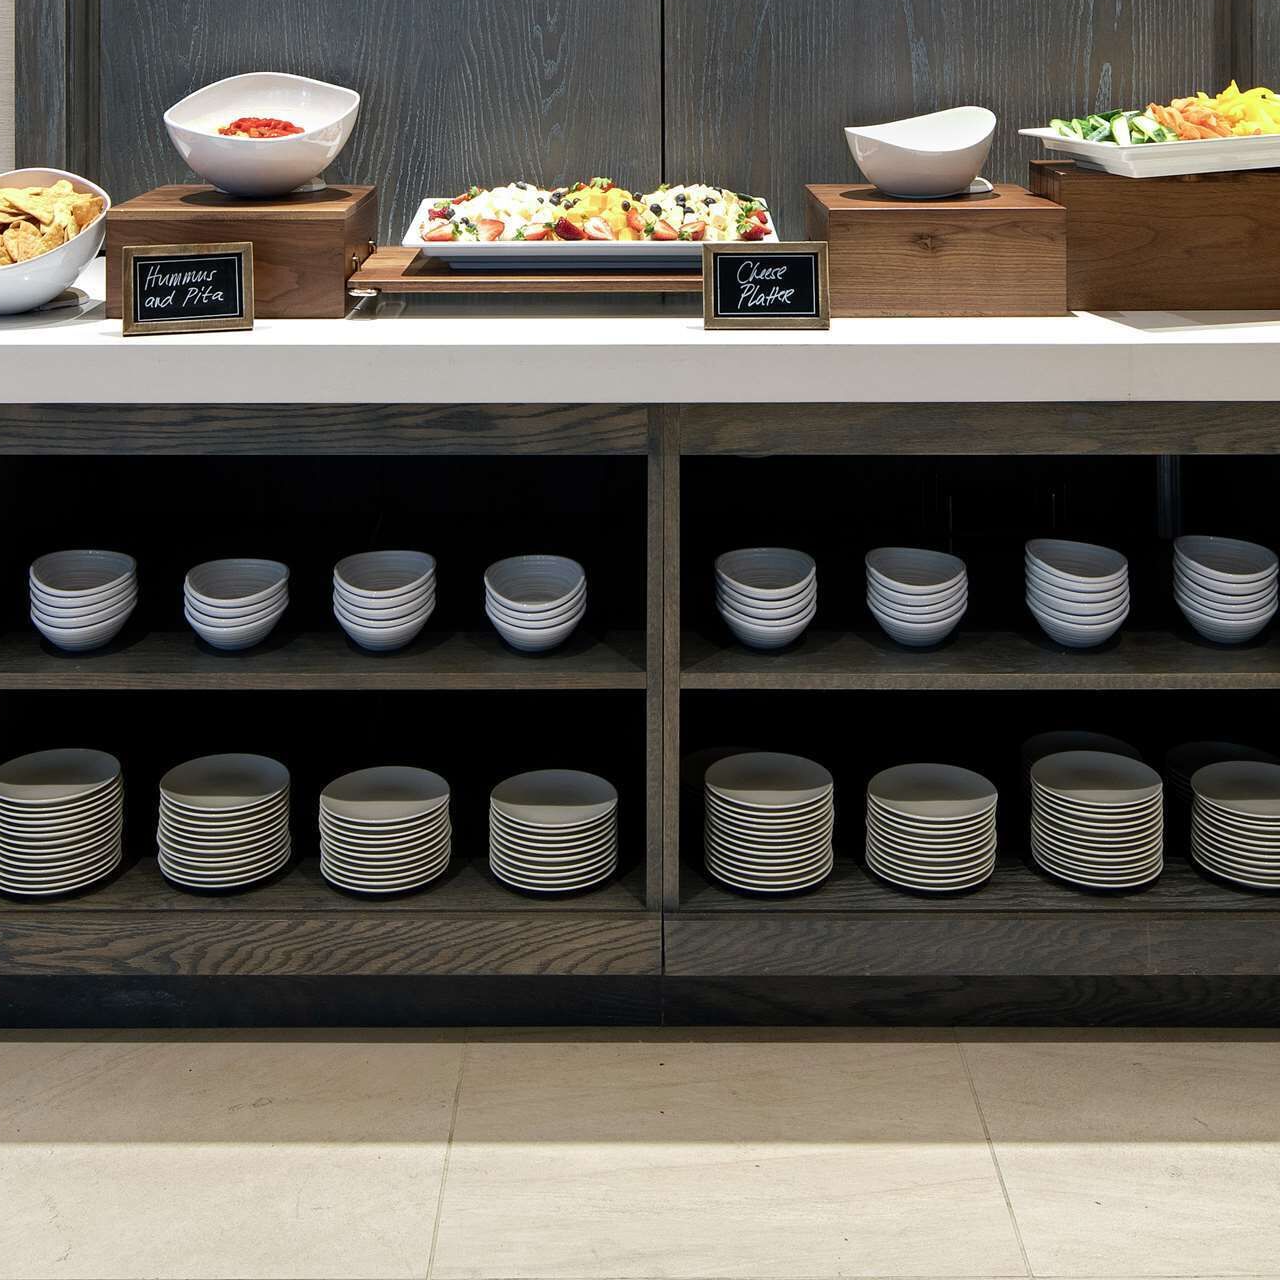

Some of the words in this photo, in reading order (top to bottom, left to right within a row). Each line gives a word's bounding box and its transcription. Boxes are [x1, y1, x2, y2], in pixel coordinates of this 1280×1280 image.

[144, 265, 218, 291] Hummus
[737, 260, 787, 284] Cheese
[144, 290, 176, 308] and
[182, 286, 225, 307] Pita
